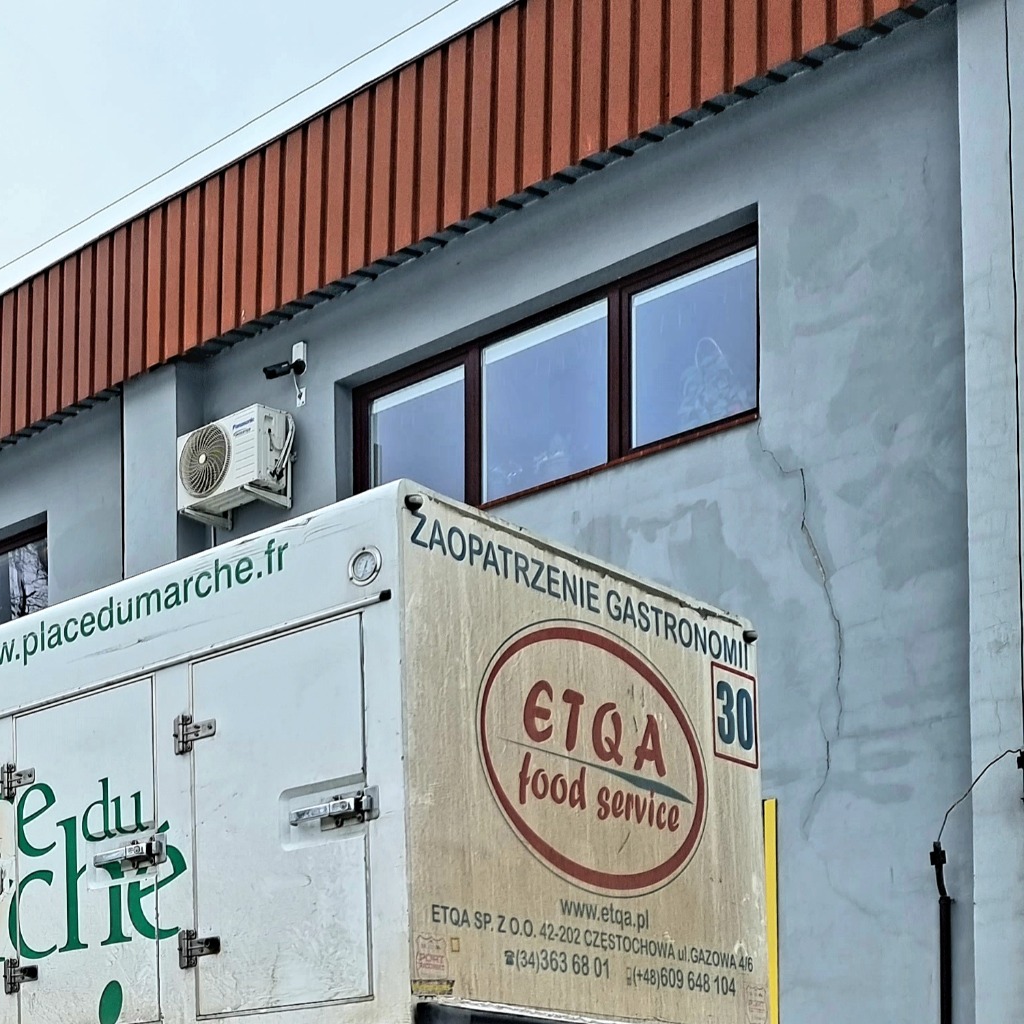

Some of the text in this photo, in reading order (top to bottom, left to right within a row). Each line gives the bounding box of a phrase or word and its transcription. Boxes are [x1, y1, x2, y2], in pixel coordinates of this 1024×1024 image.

[410, 511, 749, 671] ZAOPATRZENIE GASTRONOMII
[523, 679, 667, 778] ETQA
[716, 680, 754, 751] 30
[81, 776, 149, 842] du
[519, 751, 680, 832] food service
[431, 903, 471, 928] ETQA
[474, 911, 494, 932] SP.
[497, 915, 507, 934] Z
[509, 917, 537, 939] O.O.
[539, 922, 581, 945] 42-202
[583, 929, 675, 960] CZĘSTOCHOWA
[559, 898, 649, 933] www.etqa.pl
[572, 953, 590, 976] 68
[593, 956, 610, 980] 01
[687, 970, 711, 993] 648
[714, 975, 736, 998] 104
